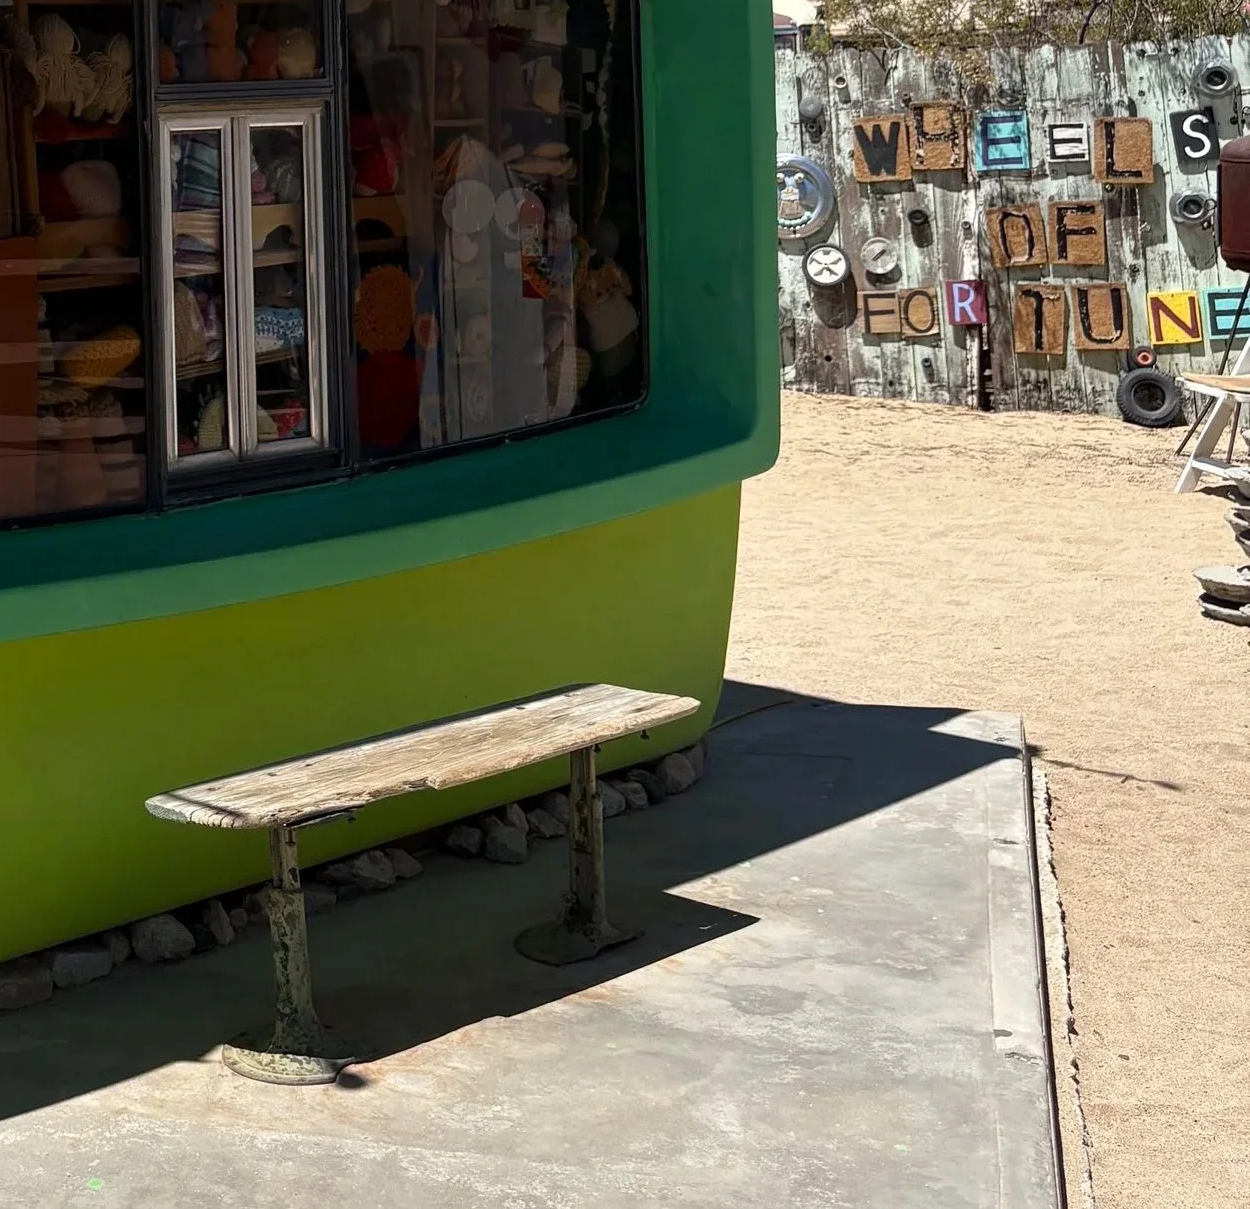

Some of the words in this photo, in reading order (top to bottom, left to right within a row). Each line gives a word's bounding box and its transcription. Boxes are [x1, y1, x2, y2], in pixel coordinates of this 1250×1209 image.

[854, 104, 1212, 179] WHEELS
[998, 205, 1098, 264] OF
[862, 281, 1250, 351] FORTUNE
